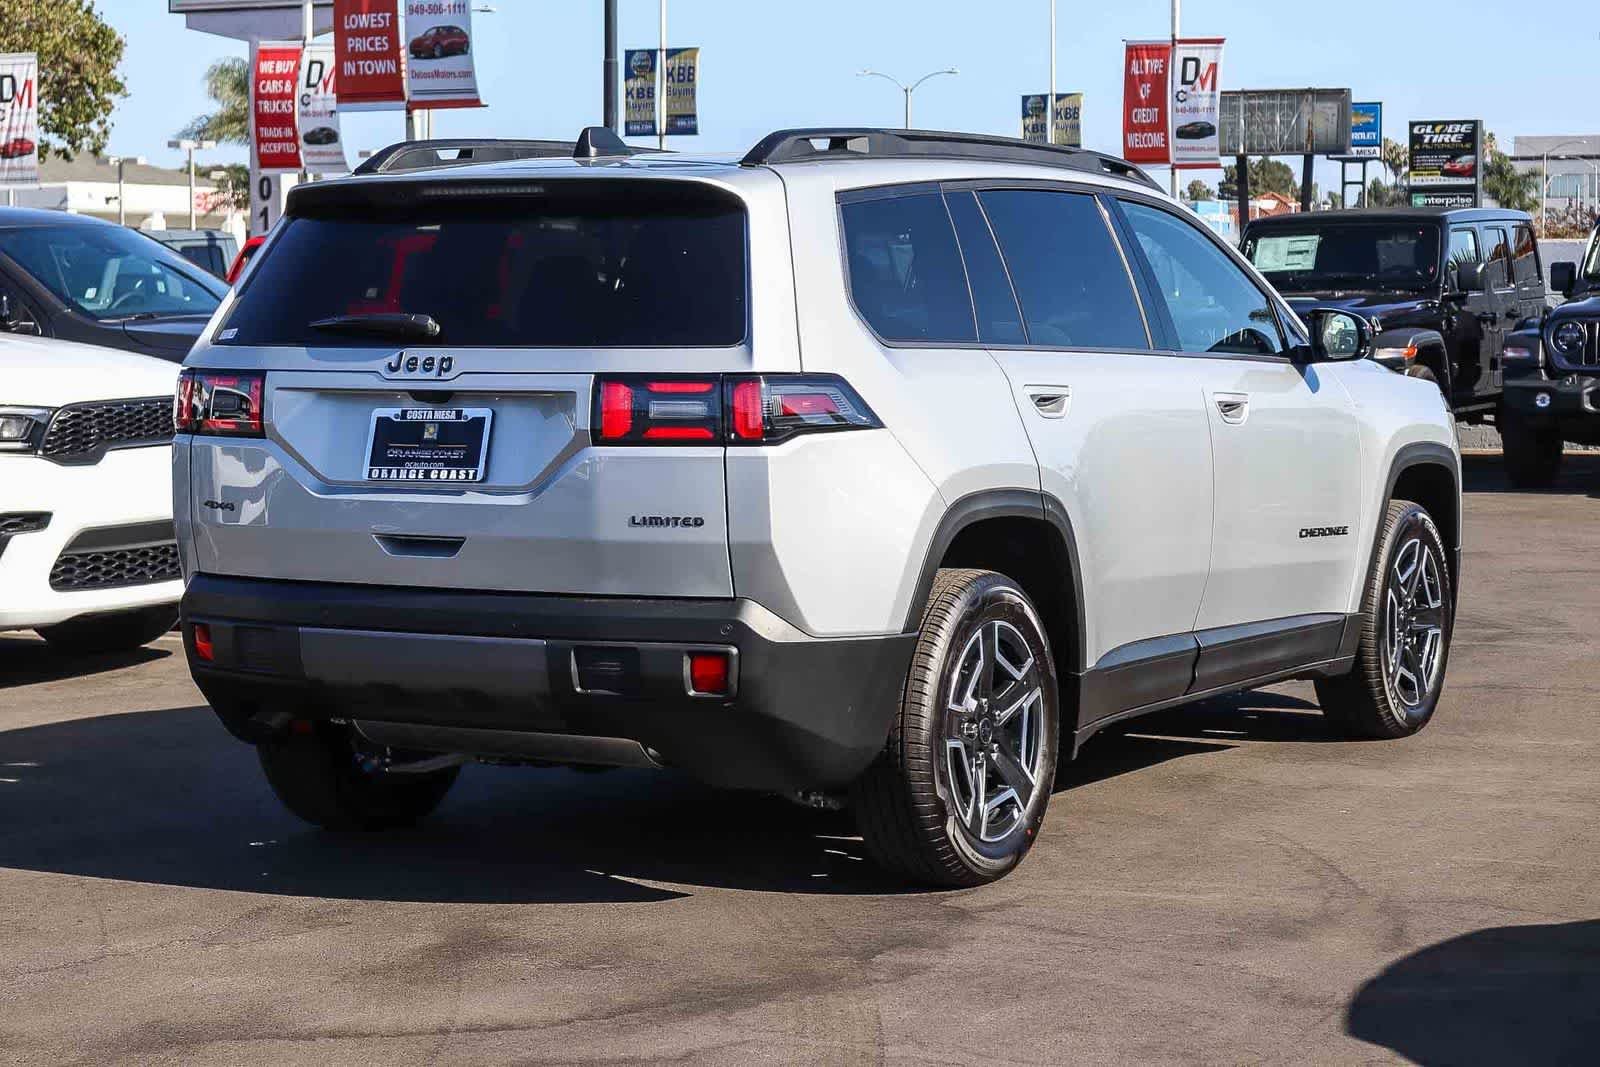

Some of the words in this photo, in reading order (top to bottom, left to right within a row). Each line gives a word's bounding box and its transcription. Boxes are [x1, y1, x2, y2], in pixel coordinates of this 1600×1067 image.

[408, 3, 466, 16] 949-506-1111
[344, 13, 392, 29] LOWEST
[347, 36, 389, 52] PRICES
[259, 61, 275, 74] WE
[275, 60, 296, 74] BUY
[344, 60, 356, 76] IN
[357, 59, 396, 75] TOWN
[1131, 60, 1144, 74] ALL
[1145, 58, 1163, 74] TYPE
[667, 65, 696, 82] KBB
[259, 80, 283, 94] CARS
[284, 80, 292, 93] &
[626, 87, 655, 100] KBB
[1141, 83, 1151, 99] OF
[258, 100, 293, 113] TRUCKS
[1056, 108, 1080, 120] KBB
[1132, 108, 1159, 123] CREDIT
[1024, 124, 1047, 134] KBB
[1413, 124, 1474, 134] GLOBE
[1128, 132, 1165, 148] WELCOME
[1423, 133, 1465, 143] TIRE
[260, 142, 296, 154] ACCEPTED
[1356, 148, 1377, 156] MESA
[1415, 195, 1472, 208] enterprise
[387, 351, 454, 377] Jeep
[406, 410, 433, 420] COSTA
[433, 410, 456, 420] MESA
[371, 469, 425, 479] ORANGE
[430, 469, 476, 480] COAST
[1299, 526, 1349, 538] CHEROKEE
